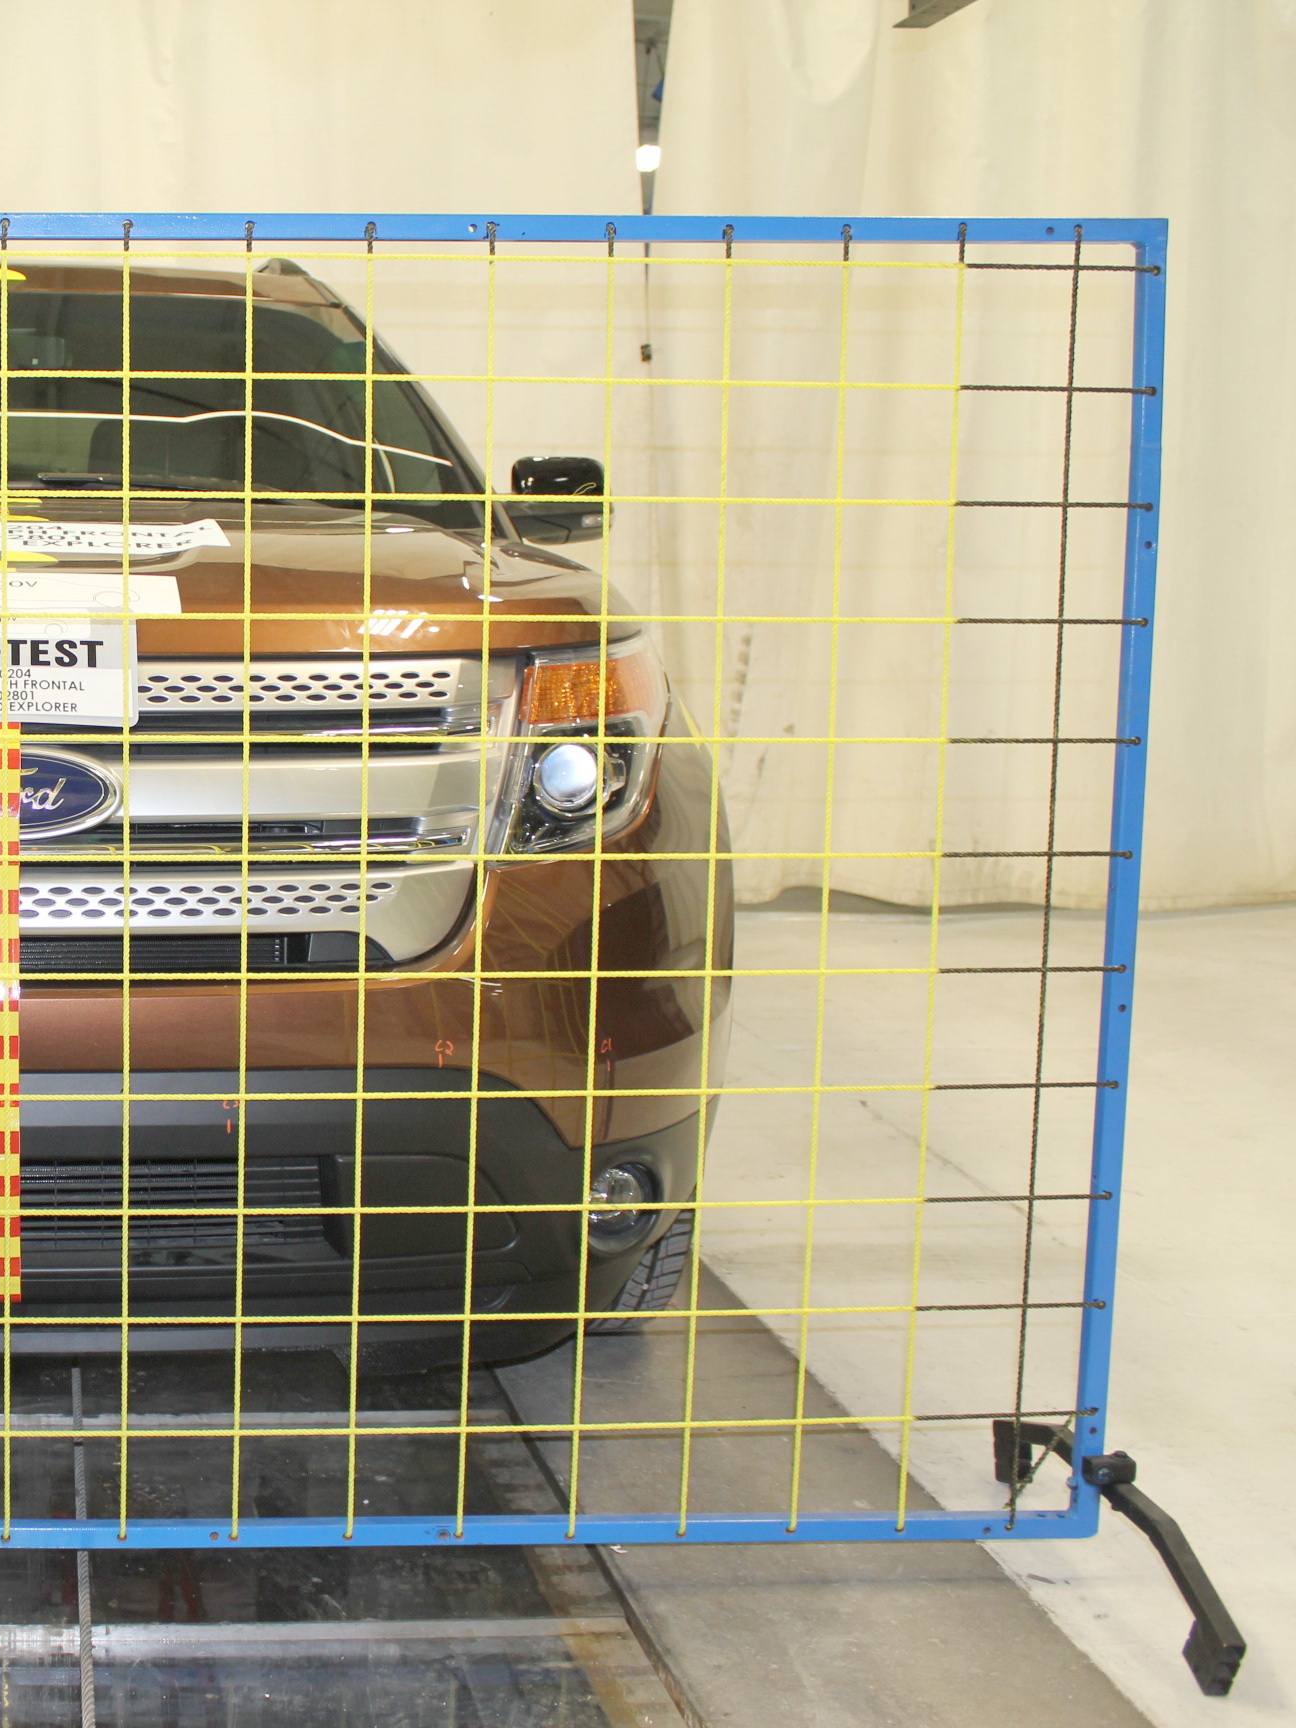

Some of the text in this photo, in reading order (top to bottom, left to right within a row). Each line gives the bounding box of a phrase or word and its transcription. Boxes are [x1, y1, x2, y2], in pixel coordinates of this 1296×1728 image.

[62, 526, 212, 537] FRONTAL
[22, 539, 192, 549] EXPLORER
[24, 680, 85, 691] FRONTAL
[10, 702, 78, 712] EXPLORER
